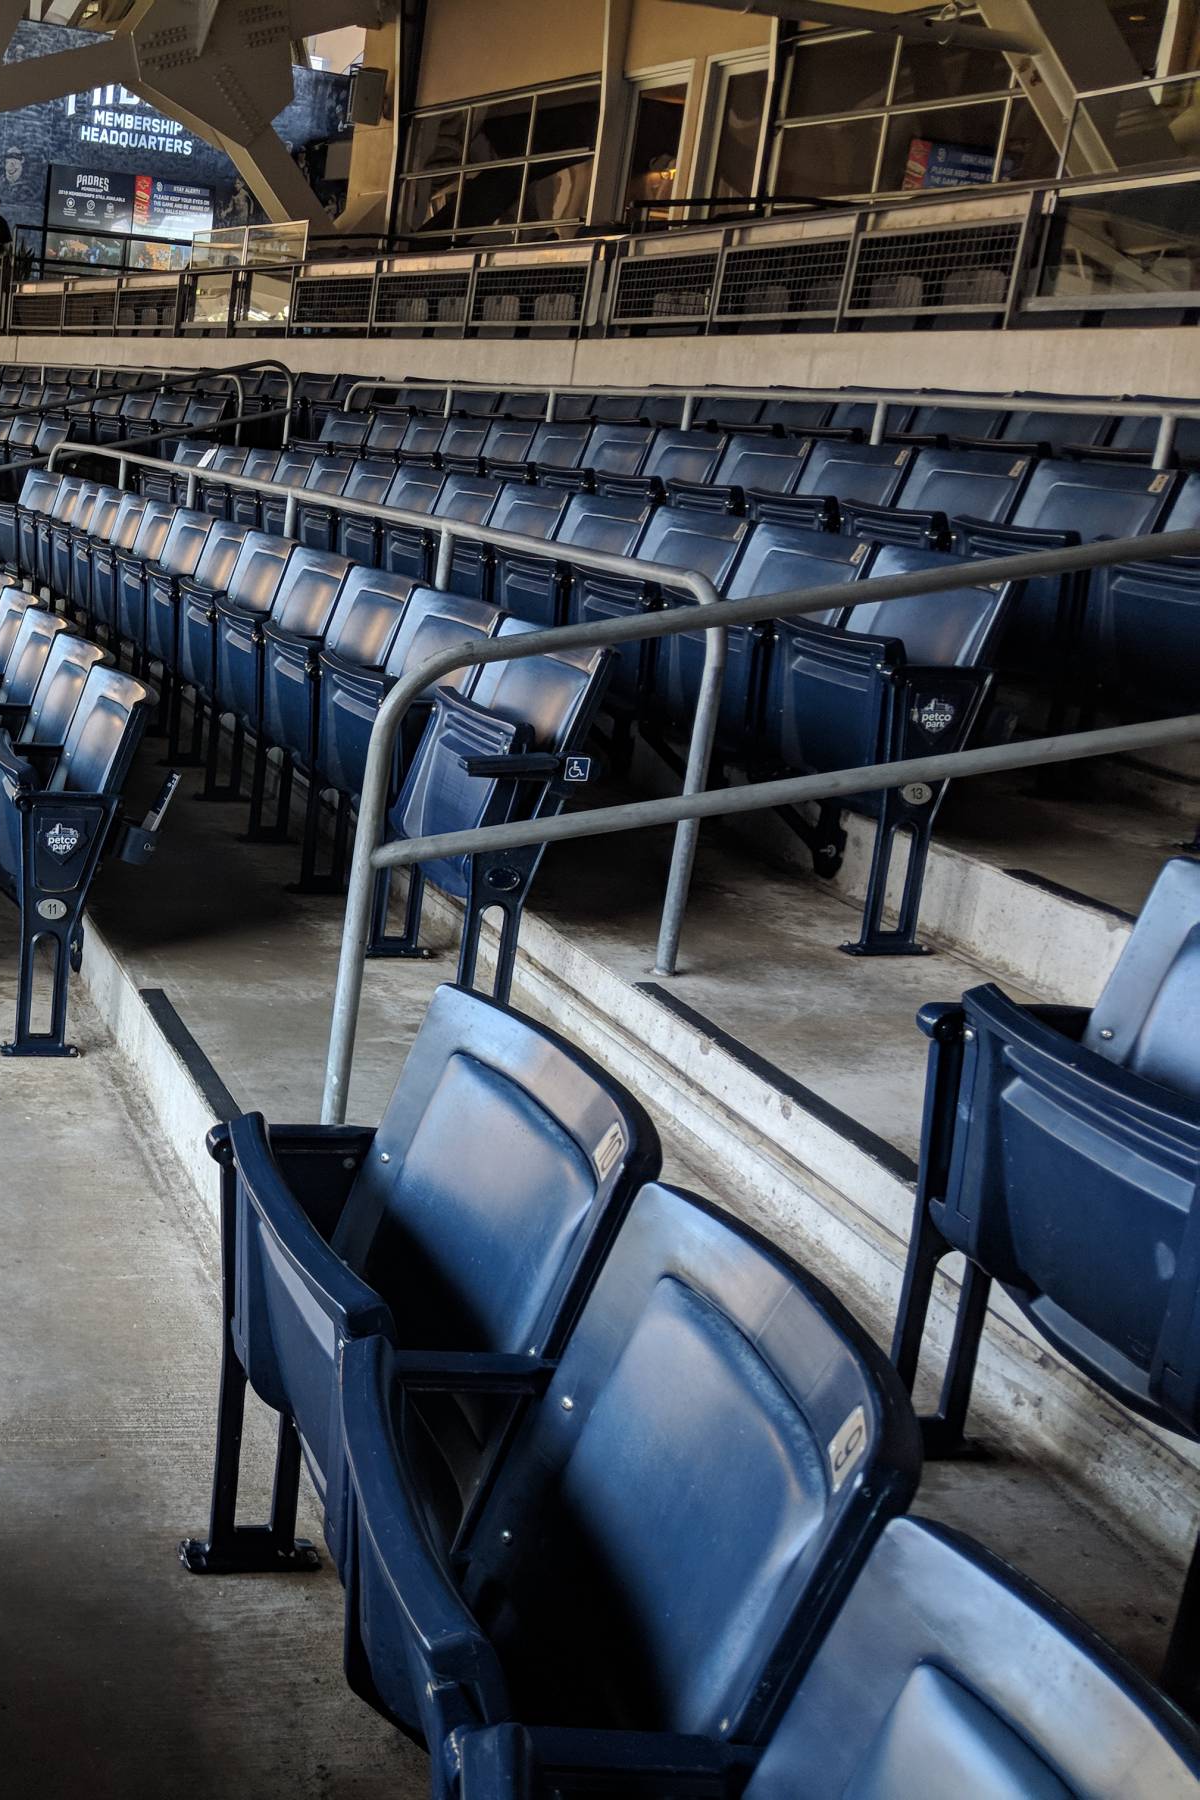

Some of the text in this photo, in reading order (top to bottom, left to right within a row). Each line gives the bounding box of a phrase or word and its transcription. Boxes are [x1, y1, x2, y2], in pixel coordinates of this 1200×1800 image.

[94, 109, 183, 136] MEMBERSHIP
[80, 125, 193, 156] HEADQUARTERS
[76, 174, 110, 192] PADRES
[921, 711, 952, 723] petco
[925, 720, 945, 730] park
[911, 787, 923, 800] 13
[47, 835, 77, 846] petco
[52, 843, 72, 852] park
[47, 904, 57, 915] 11
[599, 1130, 622, 1172] 10
[834, 1424, 863, 1472] 9
